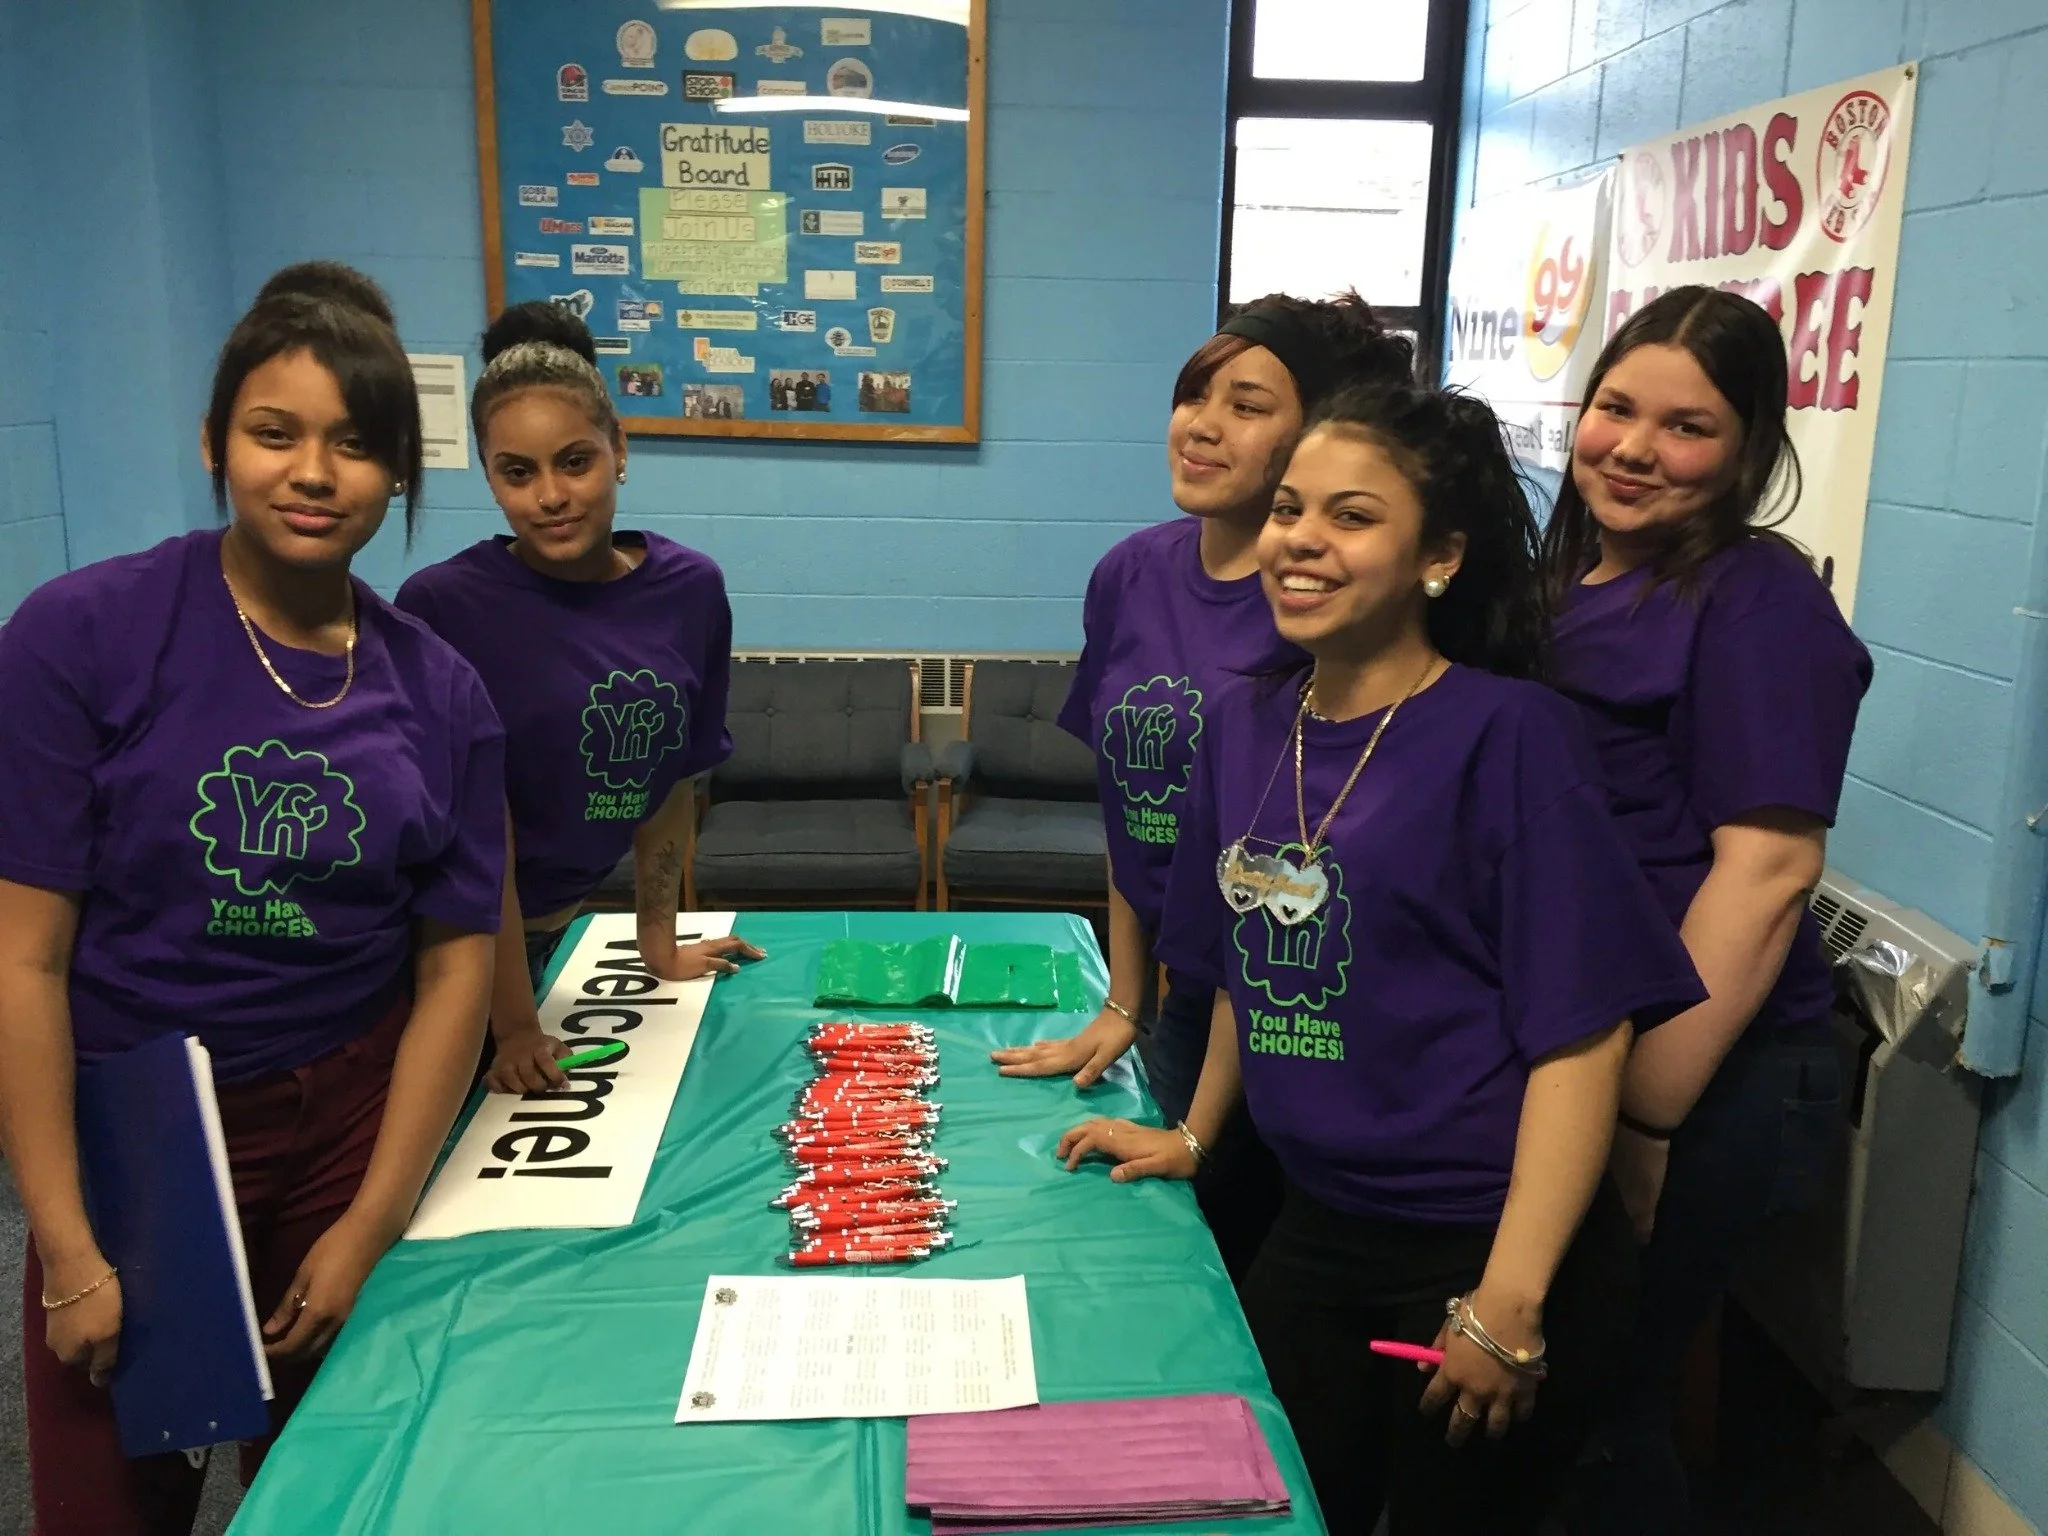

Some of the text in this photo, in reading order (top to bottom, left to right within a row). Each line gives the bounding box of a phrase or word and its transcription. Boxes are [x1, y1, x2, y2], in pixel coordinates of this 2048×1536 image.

[663, 125, 771, 155] Gratitude
[679, 160, 750, 187] Board
[670, 188, 748, 211] Please
[1667, 112, 1804, 263] KIDS
[664, 216, 755, 240] Join Us
[574, 251, 625, 265] Marcotte
[1532, 234, 1585, 334] 99
[587, 790, 650, 806] You Hav
[584, 803, 650, 822] CHOICE
[1141, 807, 1177, 827] Have
[210, 898, 306, 920] You Hav
[1248, 1008, 1341, 1038] You Have
[1248, 1031, 1345, 1061] CHOICES!
